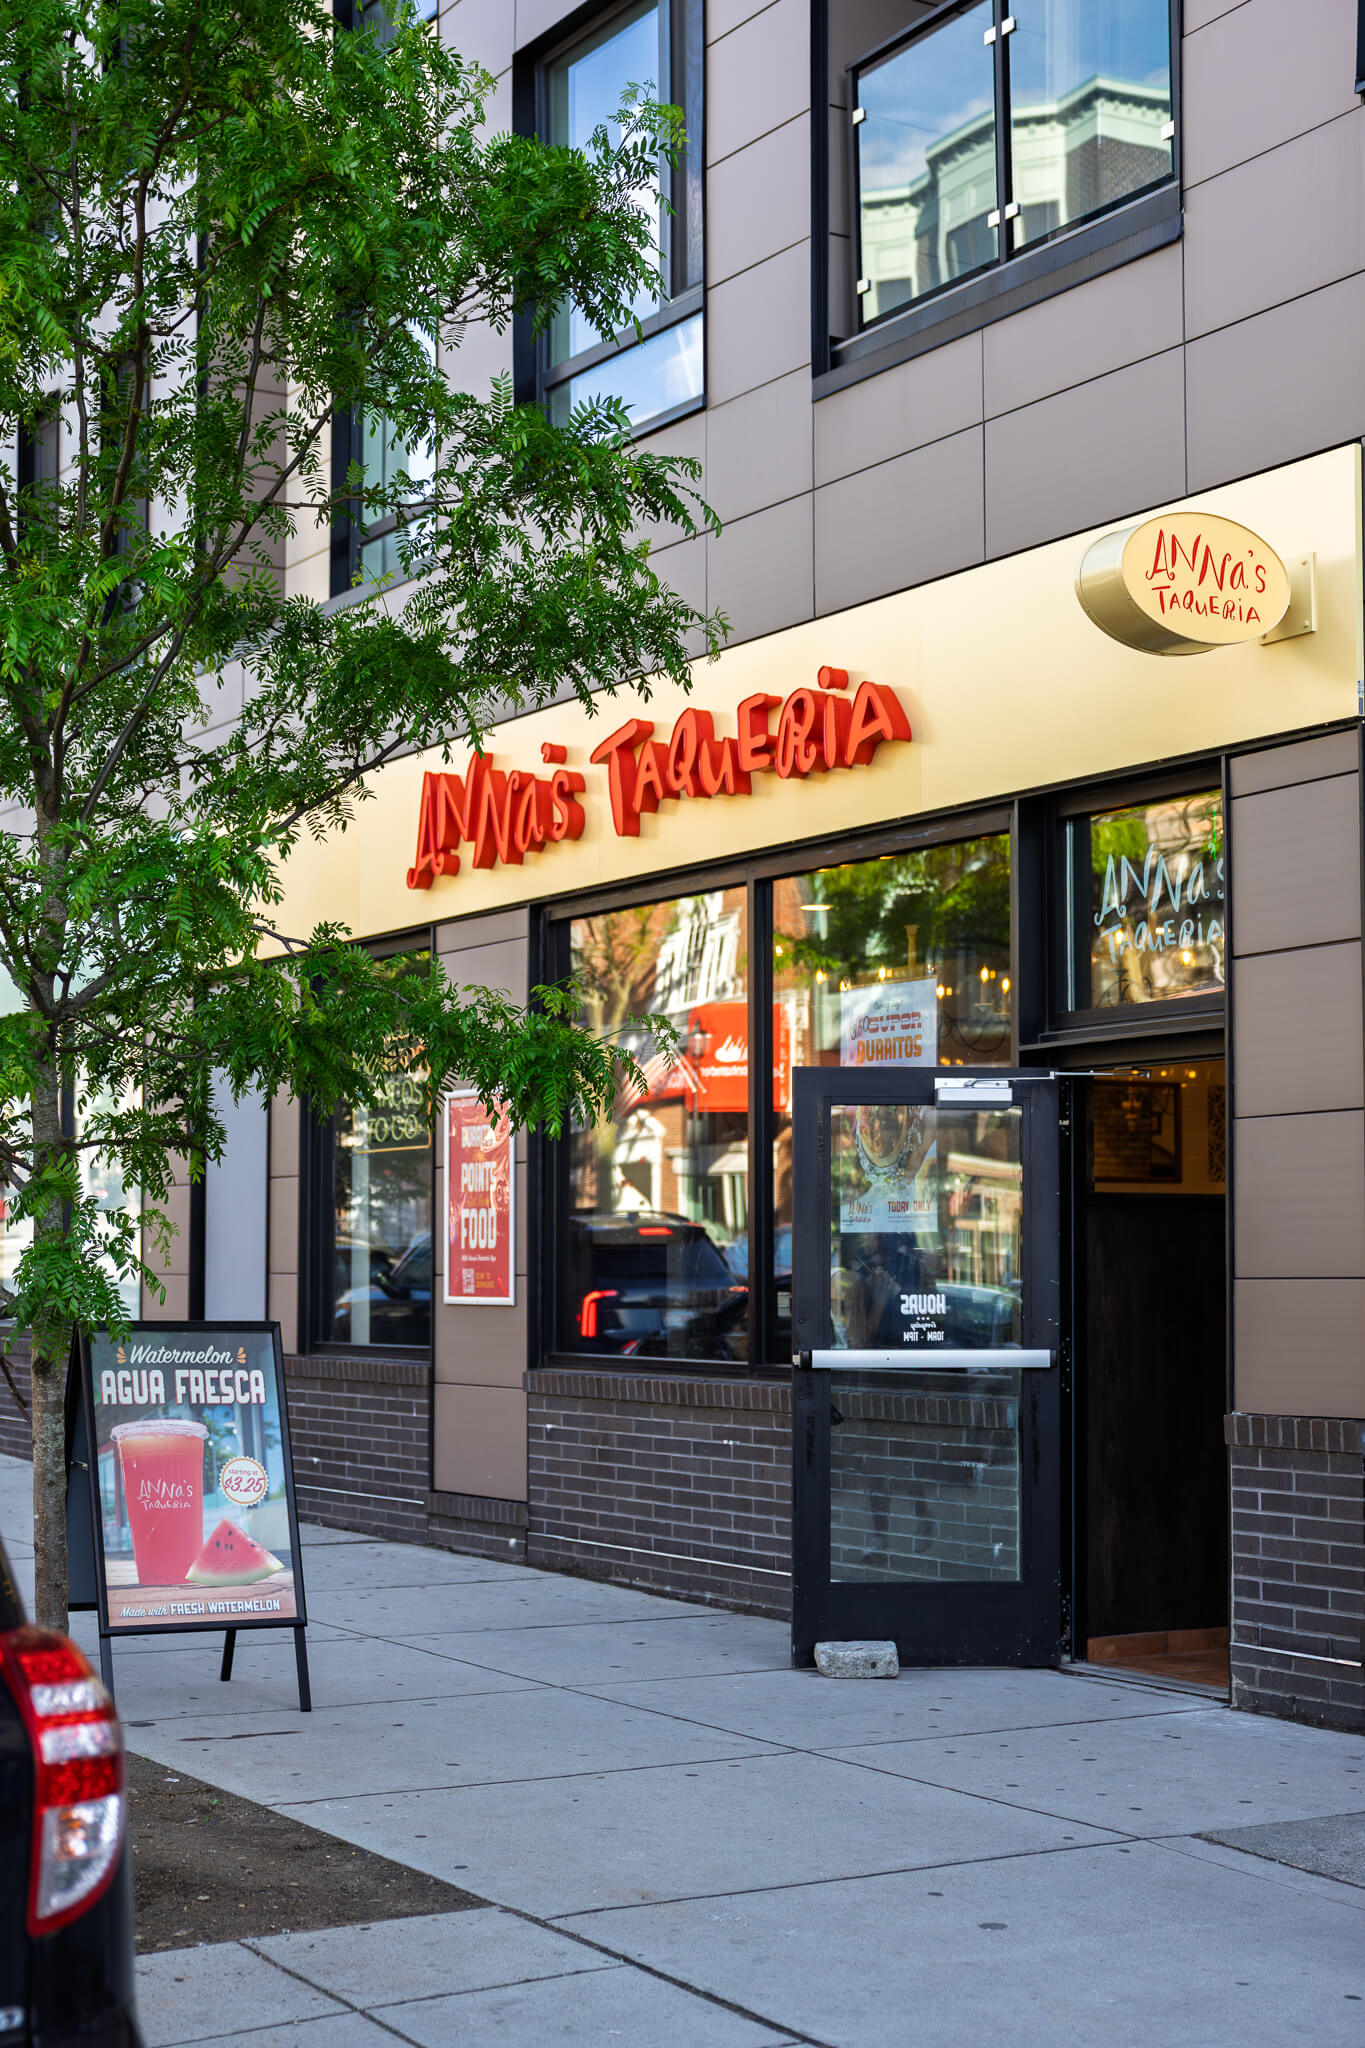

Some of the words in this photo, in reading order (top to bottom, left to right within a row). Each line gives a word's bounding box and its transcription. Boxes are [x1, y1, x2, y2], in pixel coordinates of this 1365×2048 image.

[868, 1011, 922, 1034] SUPER
[461, 1161, 497, 1192] POINTS
[887, 1200, 910, 1213] TODAY
[461, 1207, 497, 1249] FOOD
[129, 1345, 234, 1365] Watermelon
[101, 1369, 166, 1405] AGUA
[175, 1369, 267, 1405] FRESCA
[223, 1476, 265, 1493] $3.25
[120, 1606, 146, 1618] Made
[148, 1604, 168, 1617] with
[169, 1602, 205, 1616] FRESH
[207, 1600, 281, 1614] WATERMELON
